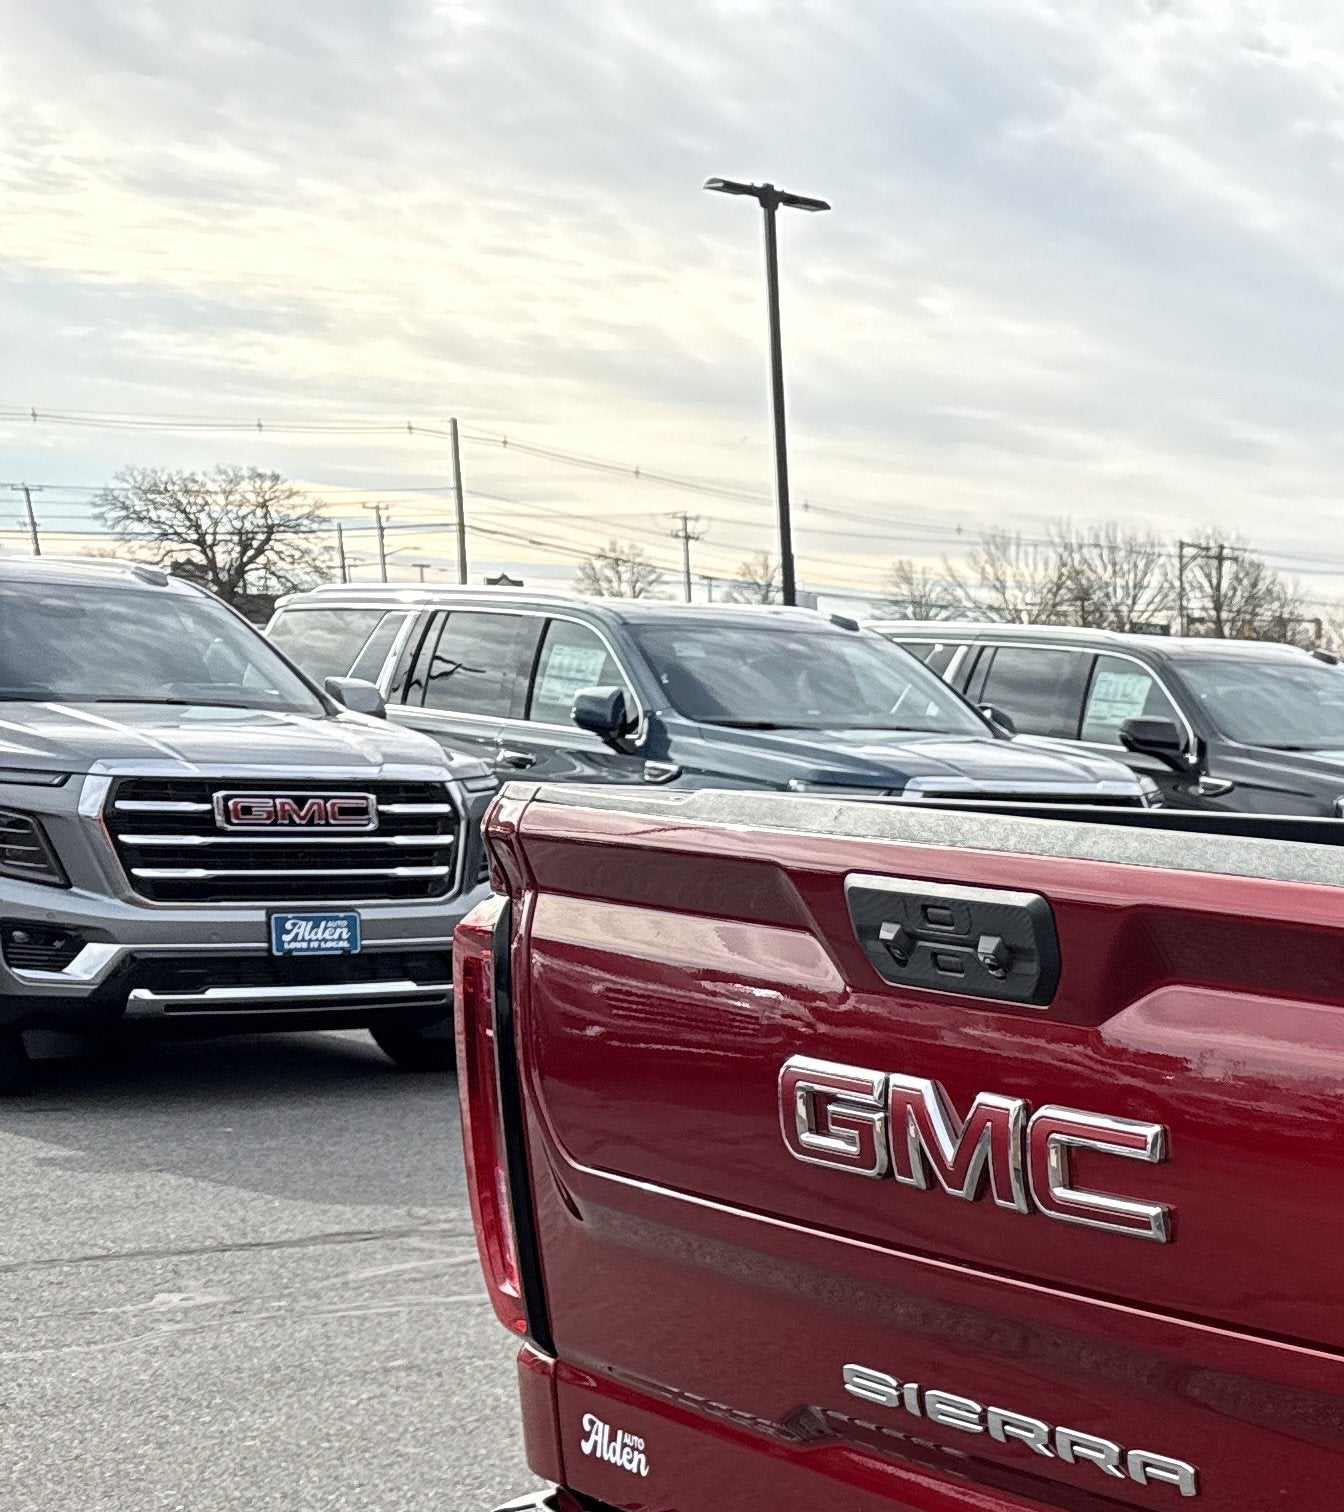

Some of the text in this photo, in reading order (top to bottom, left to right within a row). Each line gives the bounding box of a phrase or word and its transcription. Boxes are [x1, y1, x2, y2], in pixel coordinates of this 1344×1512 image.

[228, 798, 369, 824] GMC
[281, 919, 351, 942] Alden
[283, 941, 308, 949] LOVE
[320, 940, 350, 948] LOCAL
[778, 1054, 1170, 1244] GMC
[623, 1432, 645, 1451] AUTO
[842, 1363, 1198, 1497] SIERRA
[580, 1413, 650, 1477] Alden
